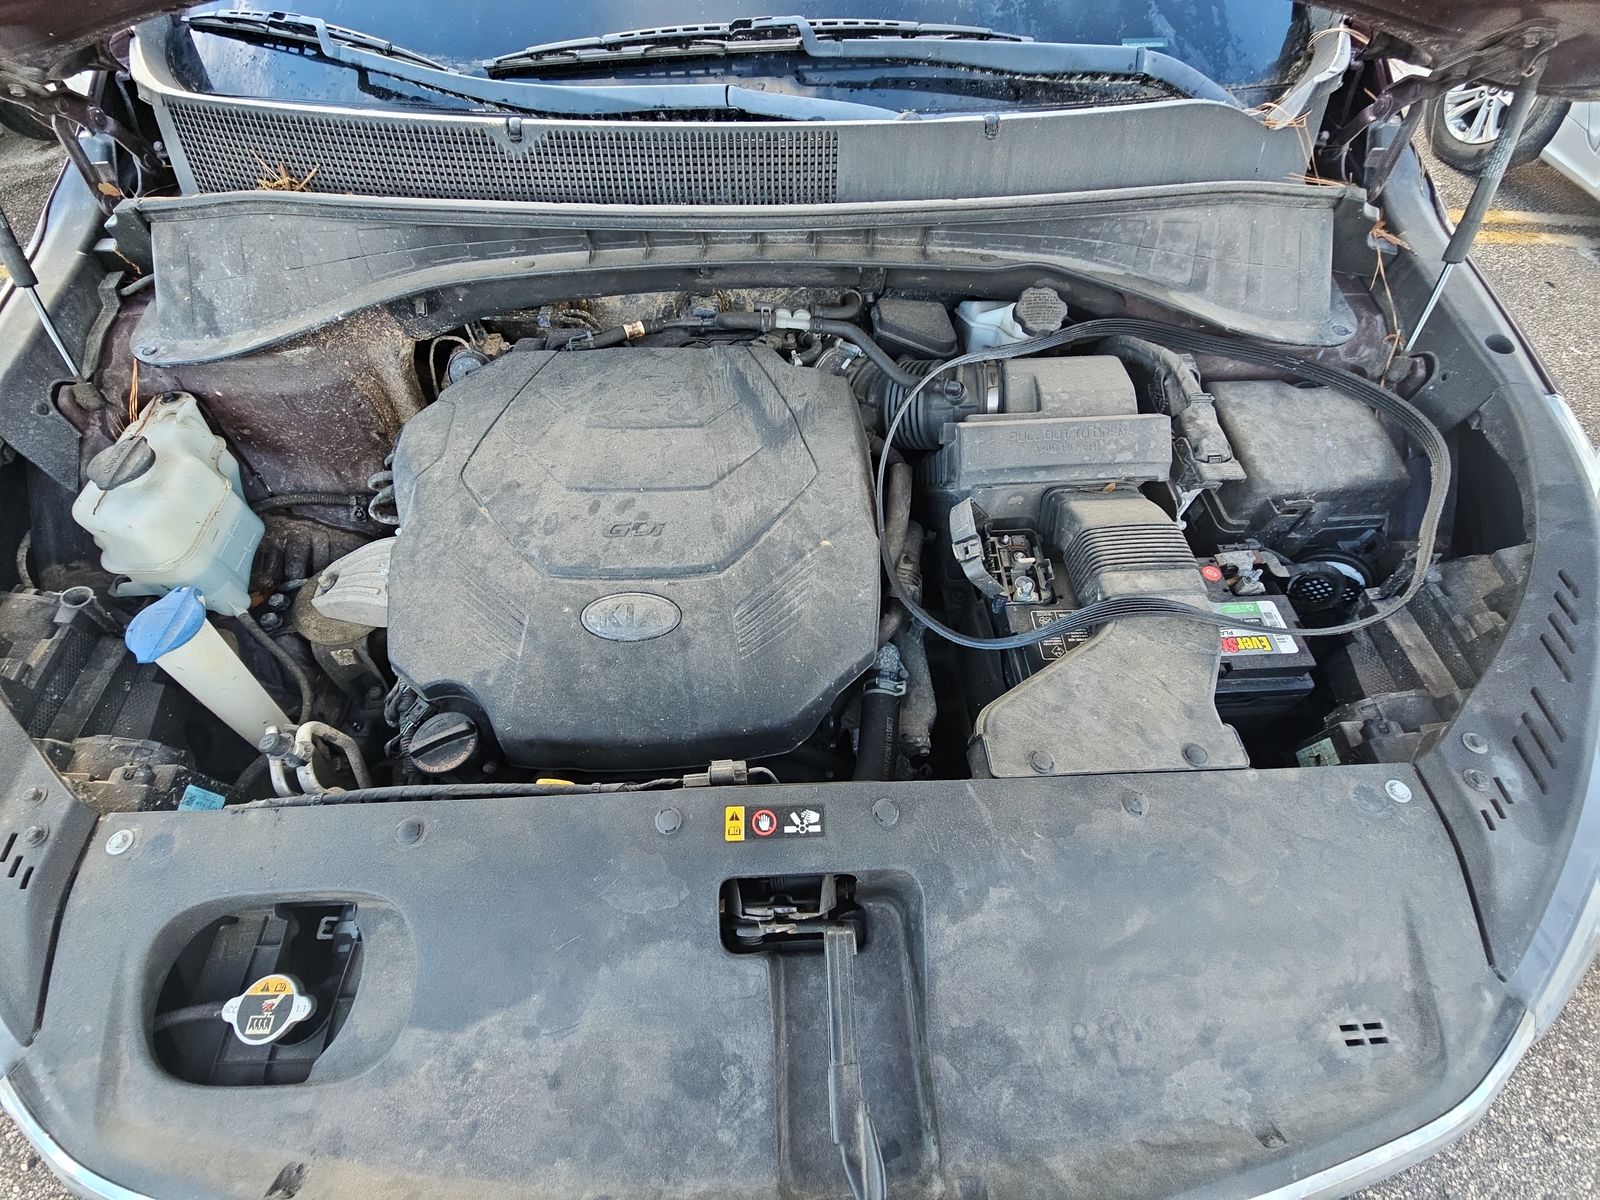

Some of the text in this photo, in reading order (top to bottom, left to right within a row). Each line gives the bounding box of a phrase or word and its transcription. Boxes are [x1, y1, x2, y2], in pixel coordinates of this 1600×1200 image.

[1009, 430, 1042, 443] PULL
[1043, 428, 1070, 441] OUT
[1075, 427, 1092, 440] TO
